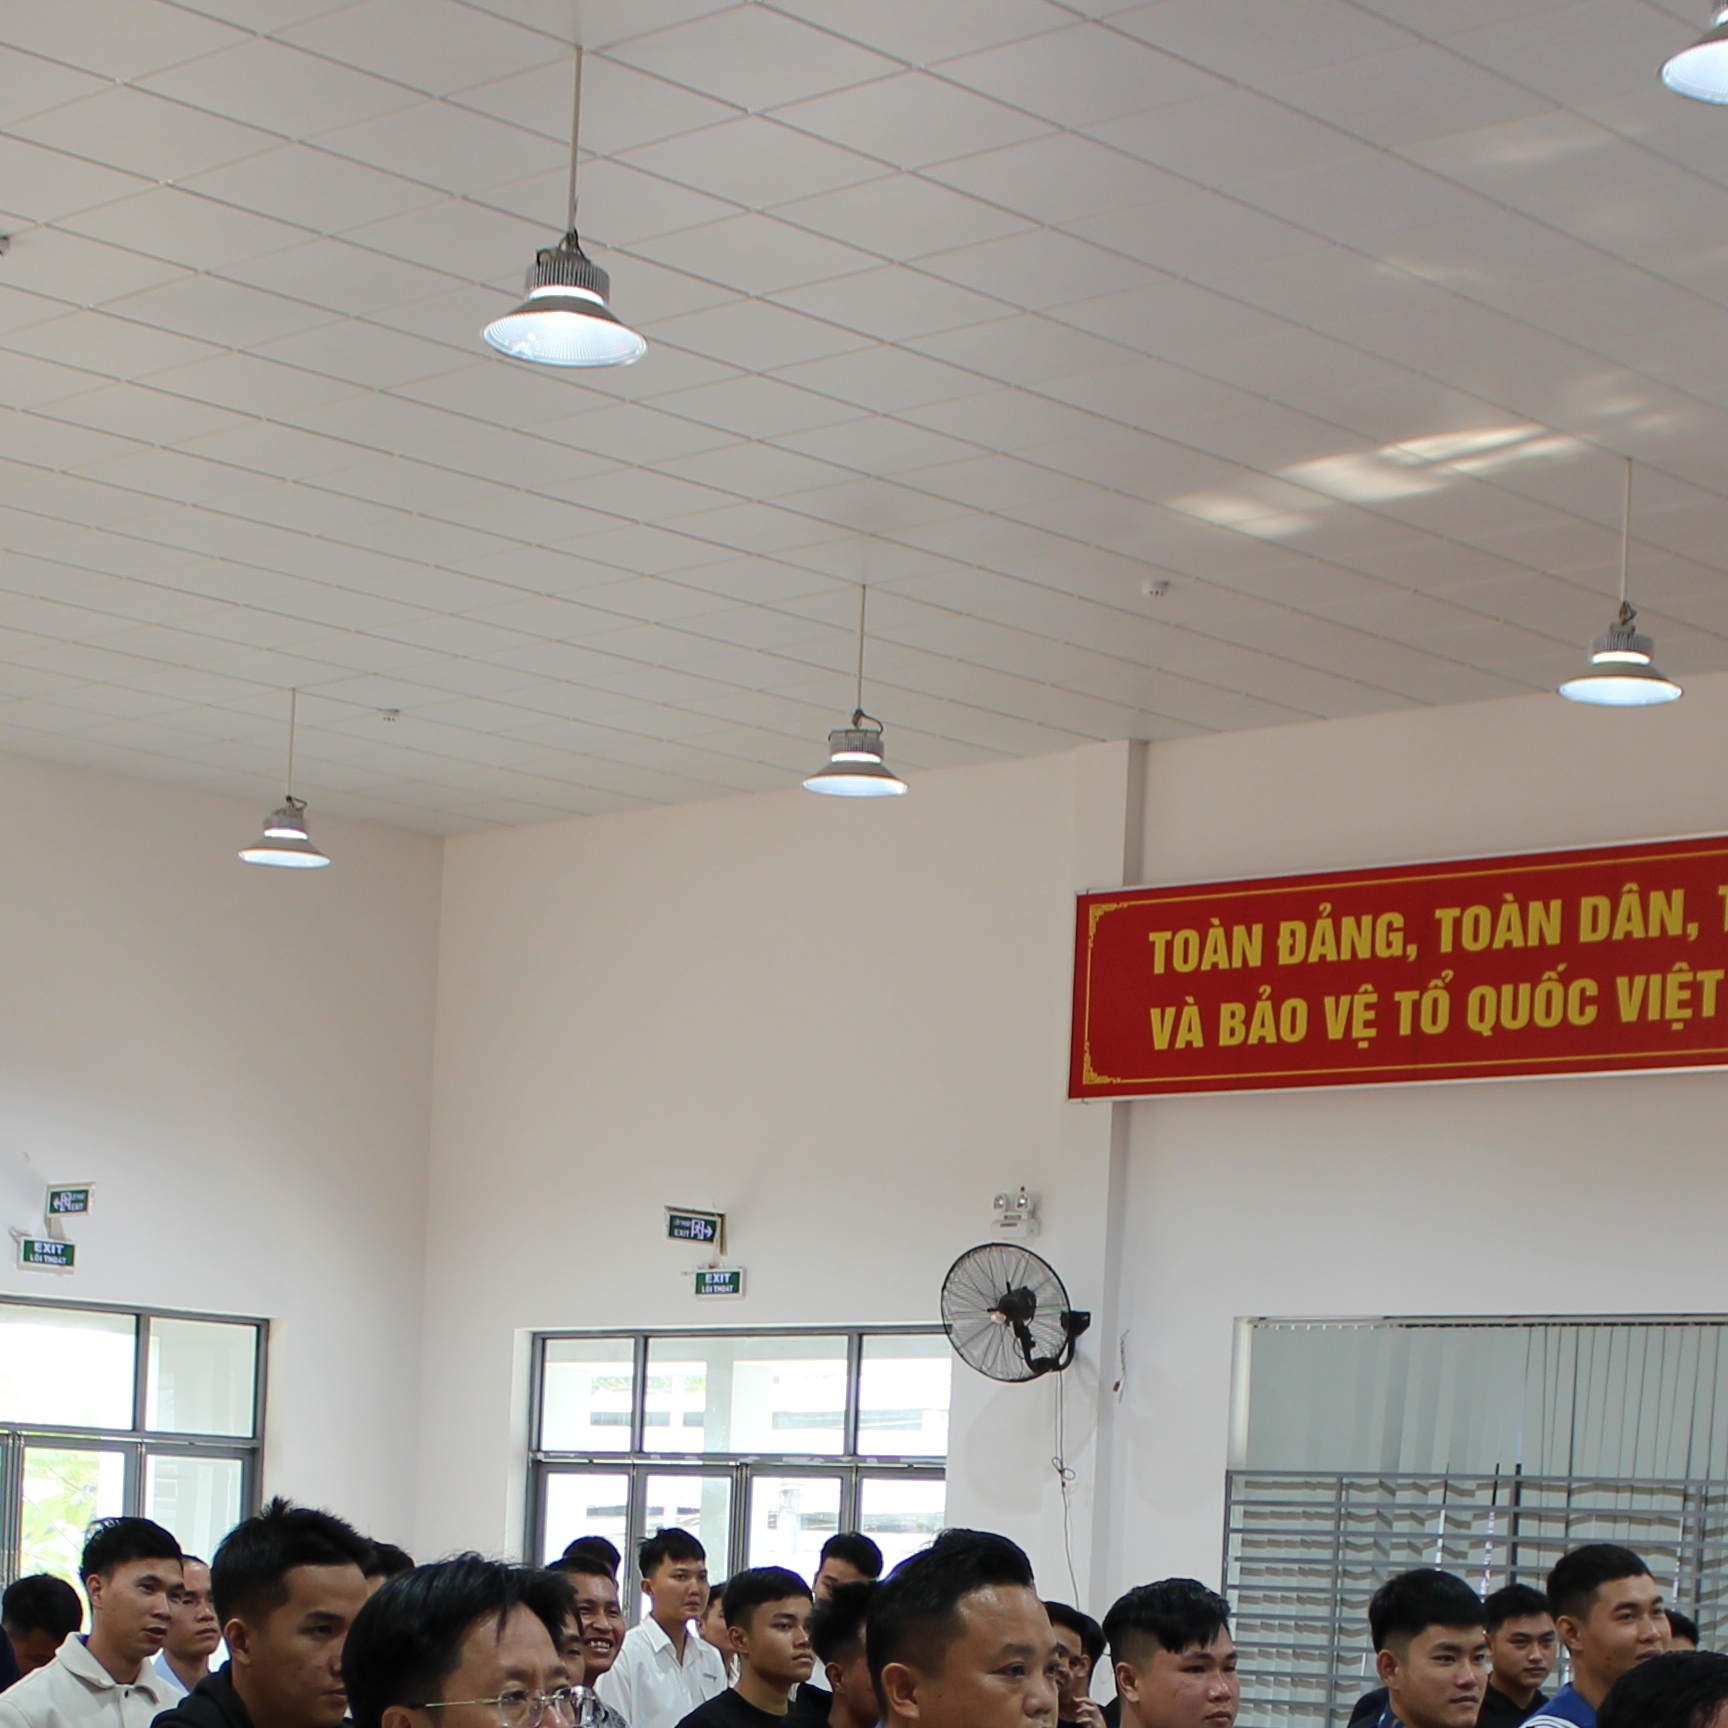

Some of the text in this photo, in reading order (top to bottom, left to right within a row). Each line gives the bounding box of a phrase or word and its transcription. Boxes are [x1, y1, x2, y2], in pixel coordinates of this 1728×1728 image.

[1149, 918, 1263, 974] TOÀN
[1277, 903, 1417, 965] ĐẢNG,
[1435, 893, 1562, 953] TOÀN
[1579, 883, 1698, 943] DÂN,
[1150, 996, 1204, 1050] VÀ
[1219, 985, 1308, 1046] BẢO
[1324, 984, 1378, 1048] VỆ
[1394, 970, 1454, 1035] TỔ
[1467, 964, 1598, 1036] QUỐC
[1616, 962, 1724, 1030] VIỆT
[33, 1242, 65, 1255] EXIT
[705, 1273, 732, 1284] EXIT
